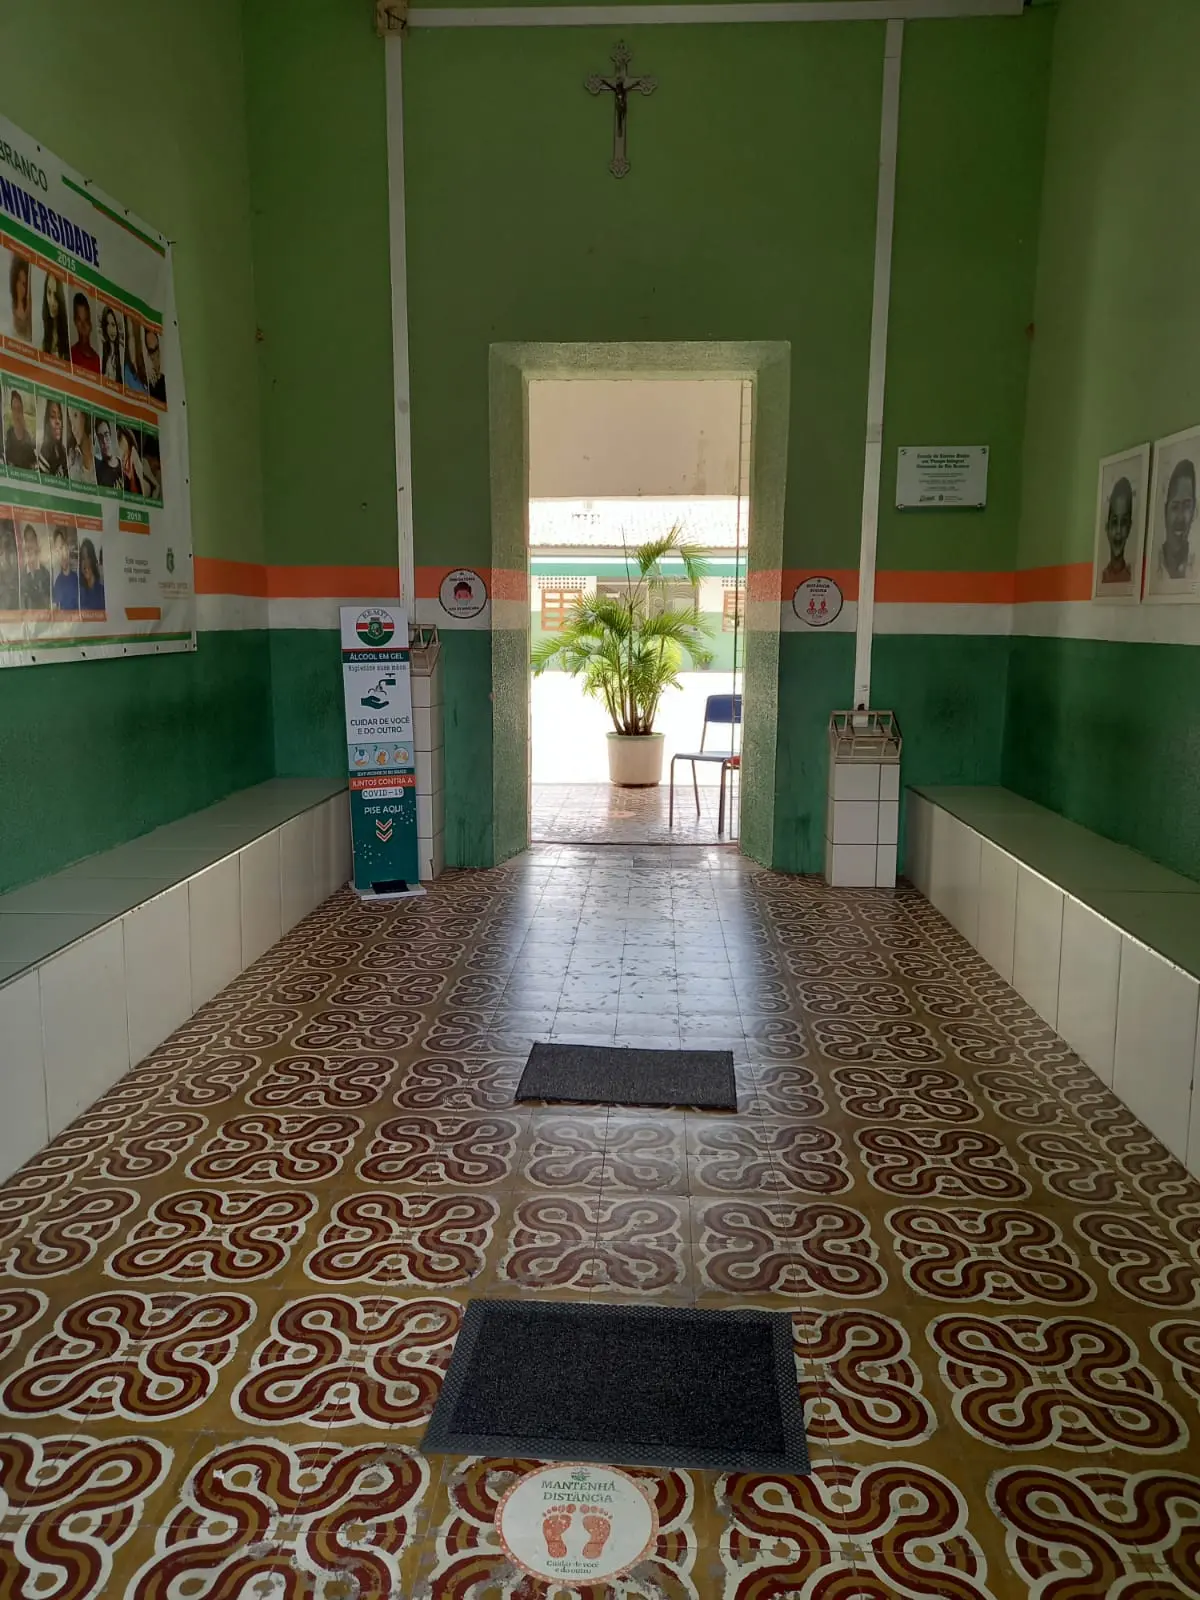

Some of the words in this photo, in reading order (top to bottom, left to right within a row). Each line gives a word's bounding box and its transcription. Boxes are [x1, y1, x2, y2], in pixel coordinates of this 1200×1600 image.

[0, 139, 48, 192] BRANCO
[0, 175, 100, 268] NIVERSIDADE
[57, 250, 76, 271] 2015
[390, 716, 410, 724] VOCÊ
[352, 779, 377, 787] JUNTOS
[362, 788, 403, 798] COVID-19
[364, 806, 381, 815] PISE
[382, 805, 403, 814] AQUI
[541, 1480, 616, 1491] MANTENHA
